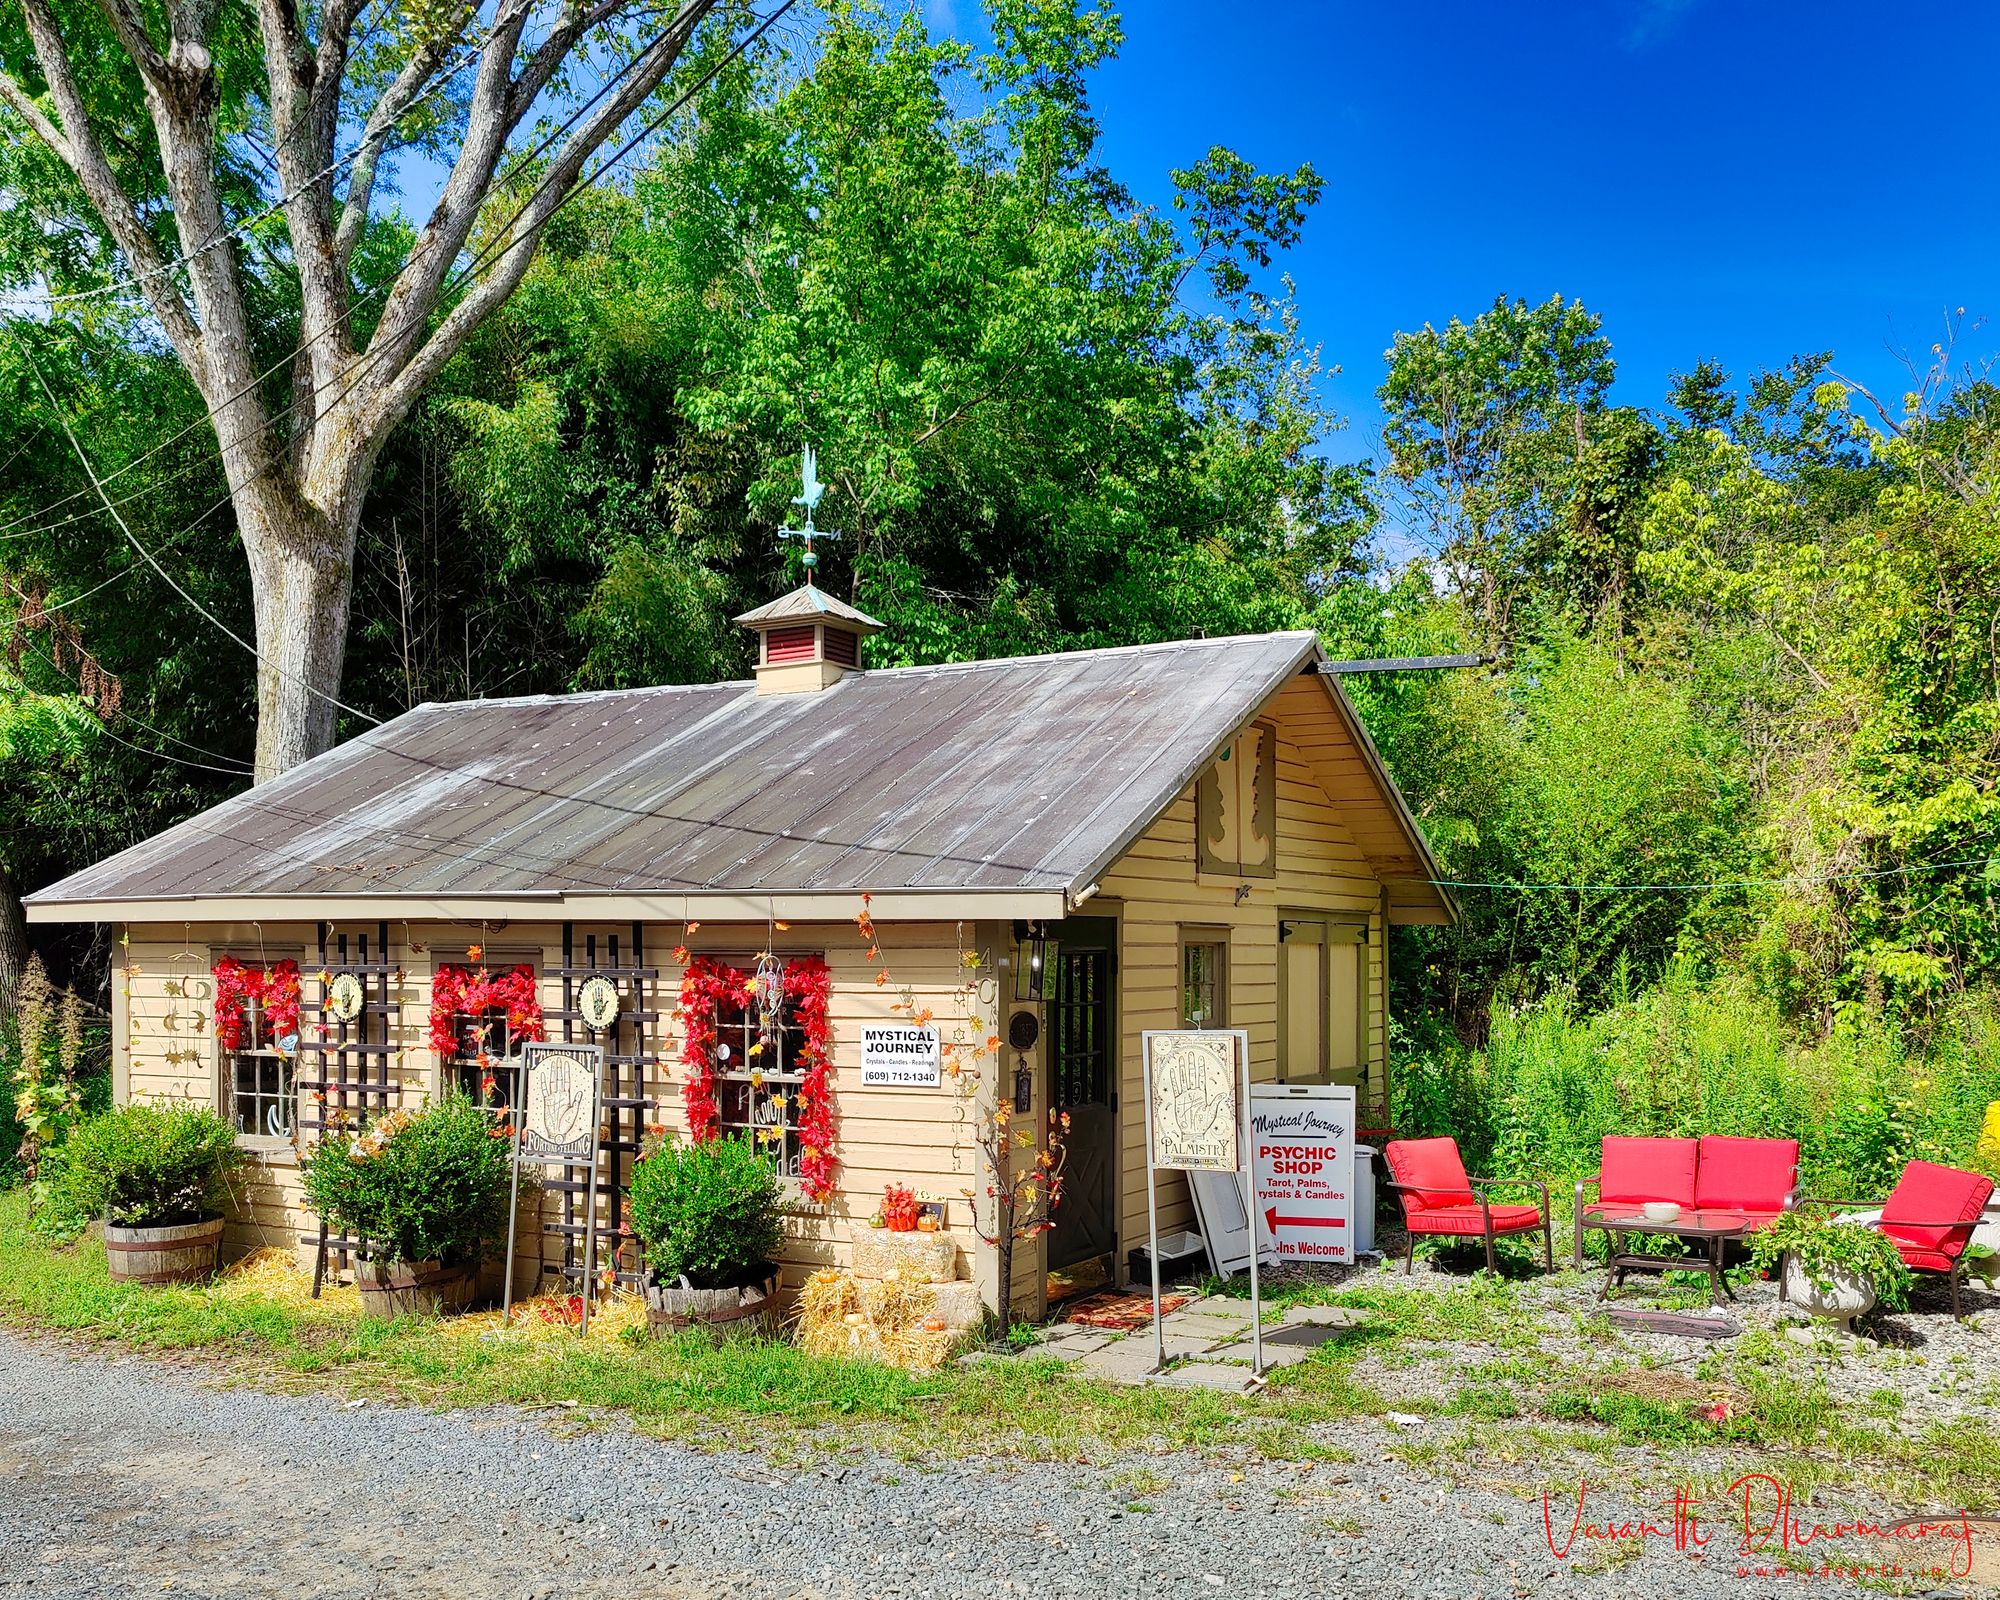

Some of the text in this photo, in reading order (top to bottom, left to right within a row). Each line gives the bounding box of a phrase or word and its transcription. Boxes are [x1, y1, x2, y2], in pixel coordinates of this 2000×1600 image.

[865, 1031, 934, 1041] MYSTICAL
[867, 1043, 933, 1053] JOURNEY
[865, 1071, 935, 1082] (609) 712-1340
[1252, 1110, 1345, 1139] Mystical Journey
[1161, 1137, 1229, 1156] PALMISTRY
[1259, 1146, 1337, 1160] PSYCHIC
[1272, 1161, 1323, 1174] SHOP
[1266, 1178, 1330, 1189] Tarot, Palms,
[1258, 1190, 1345, 1199] rystals & Candles
[1274, 1240, 1345, 1256] -Ins Welcome
